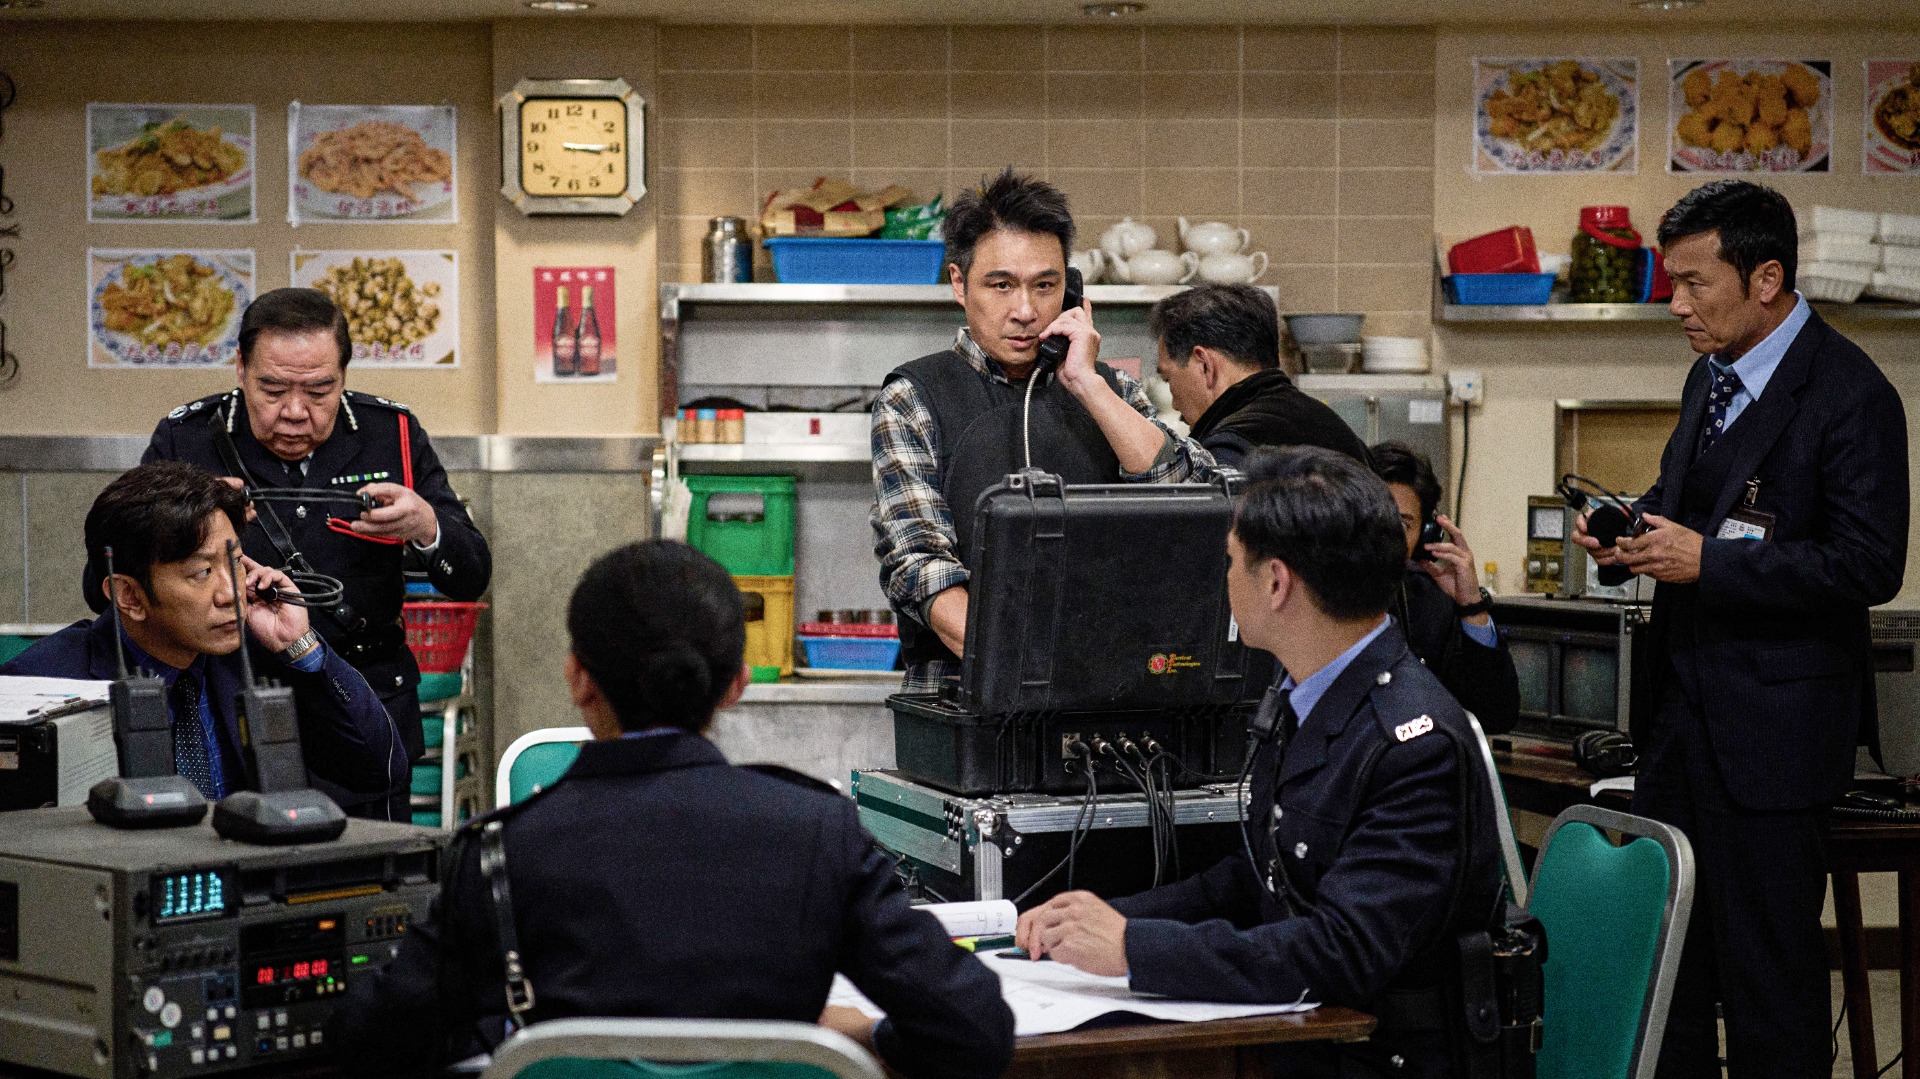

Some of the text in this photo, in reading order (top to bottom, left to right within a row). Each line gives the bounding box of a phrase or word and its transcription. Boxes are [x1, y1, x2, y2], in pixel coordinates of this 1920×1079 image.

[548, 108, 560, 119] 11
[566, 105, 583, 116] 12
[591, 108, 598, 120] 1
[531, 122, 546, 133] 10
[604, 121, 615, 133] 2
[527, 142, 539, 153] 9
[533, 163, 545, 174] 8
[605, 163, 614, 174] 4
[550, 176, 560, 187] 7
[568, 179, 580, 190] 6
[589, 176, 600, 187] 5
